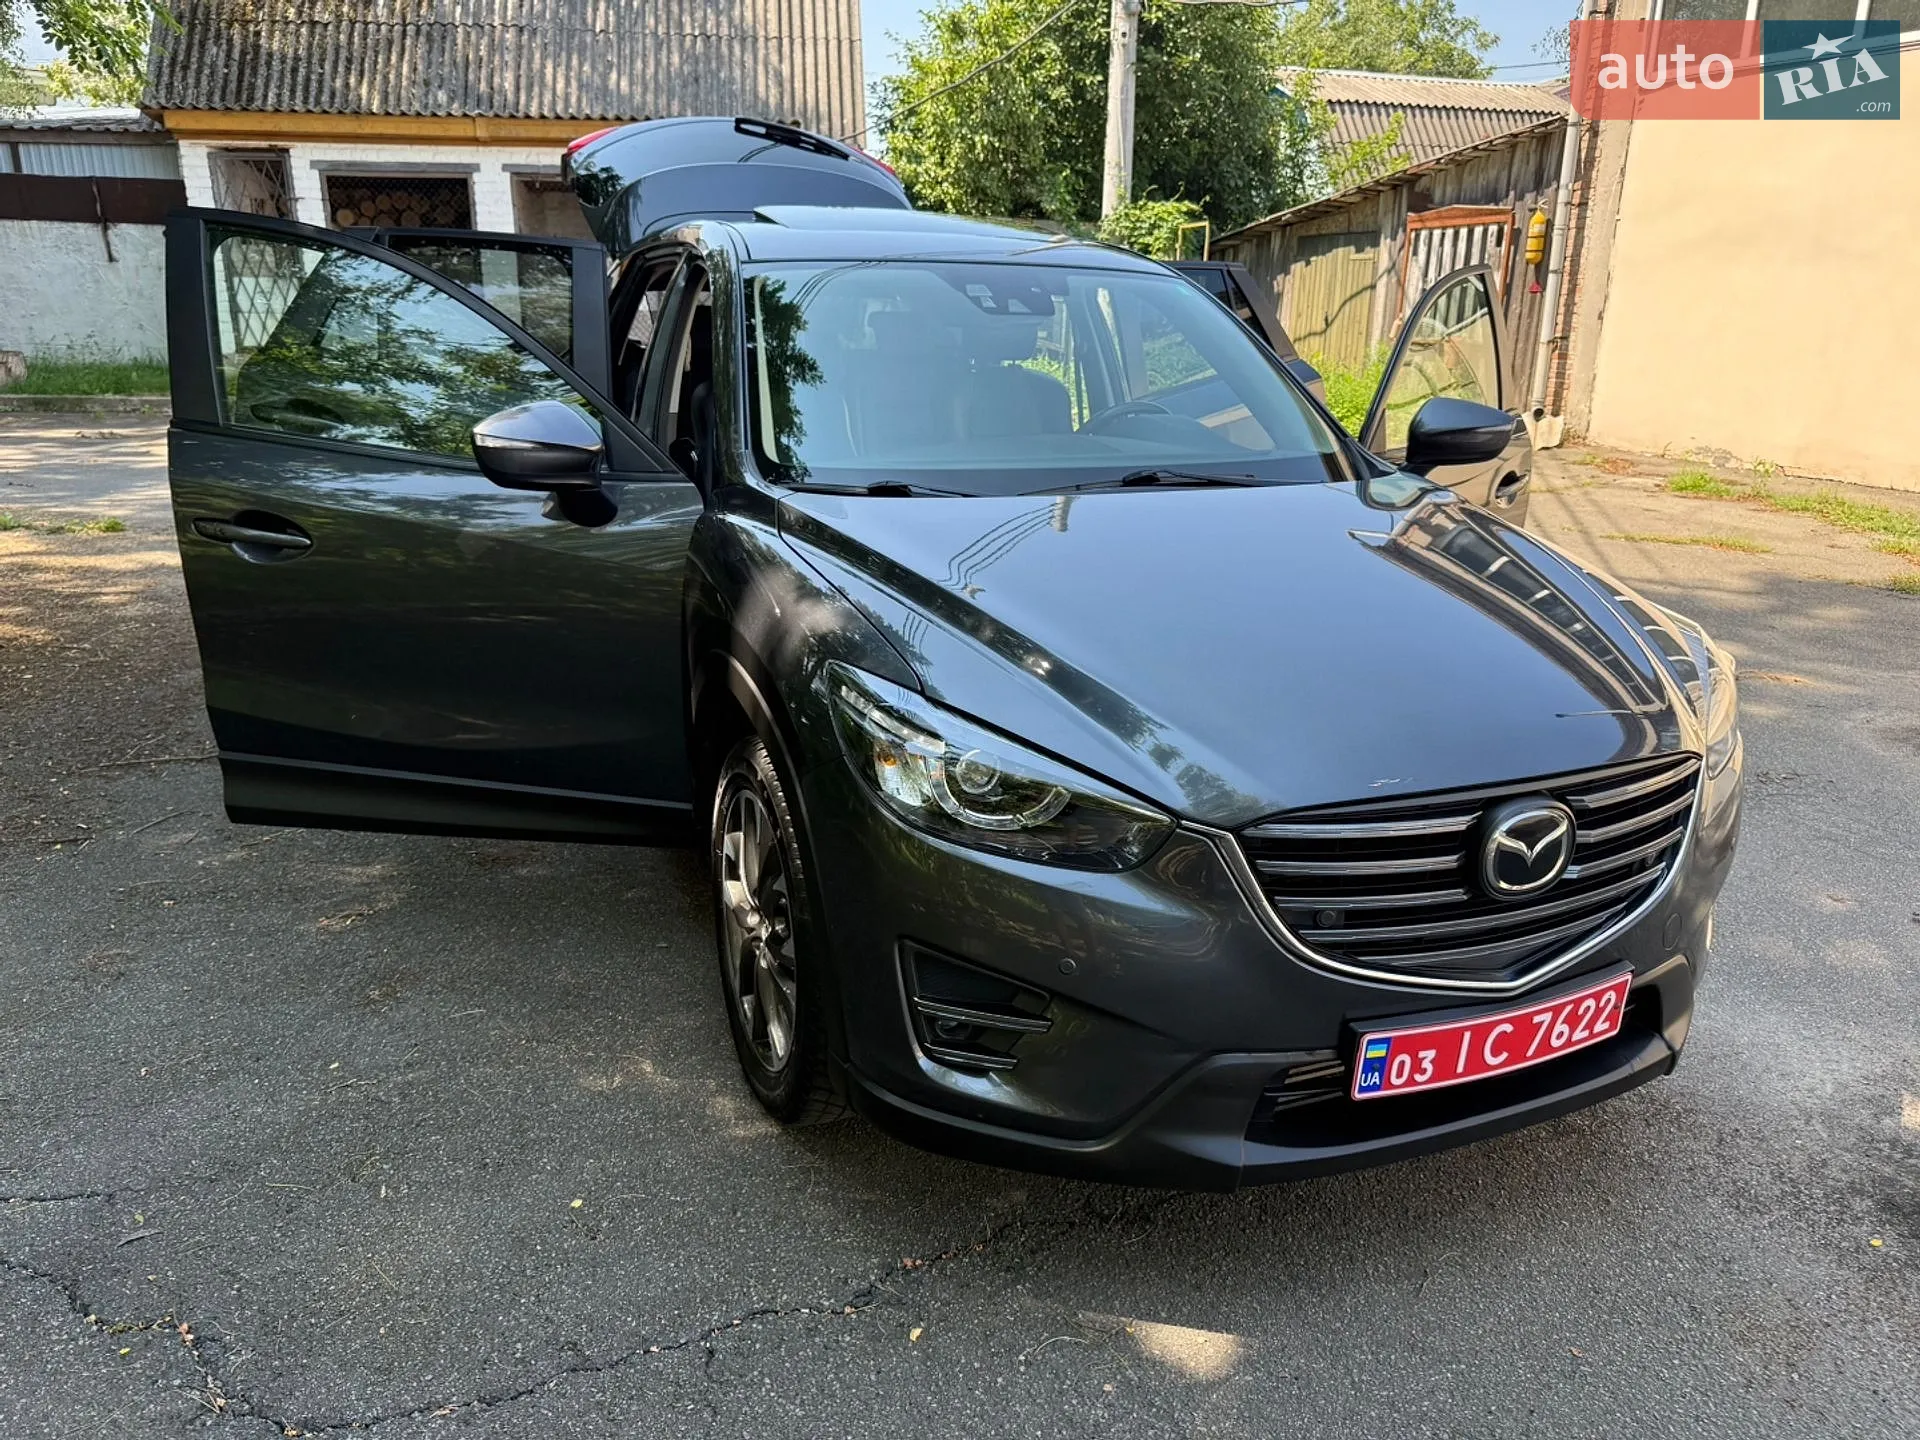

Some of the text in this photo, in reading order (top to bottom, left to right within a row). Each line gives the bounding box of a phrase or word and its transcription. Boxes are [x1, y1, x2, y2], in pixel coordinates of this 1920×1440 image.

[1390, 989, 1617, 1086] 03 IC 7622
[1361, 1071, 1380, 1087] UA
